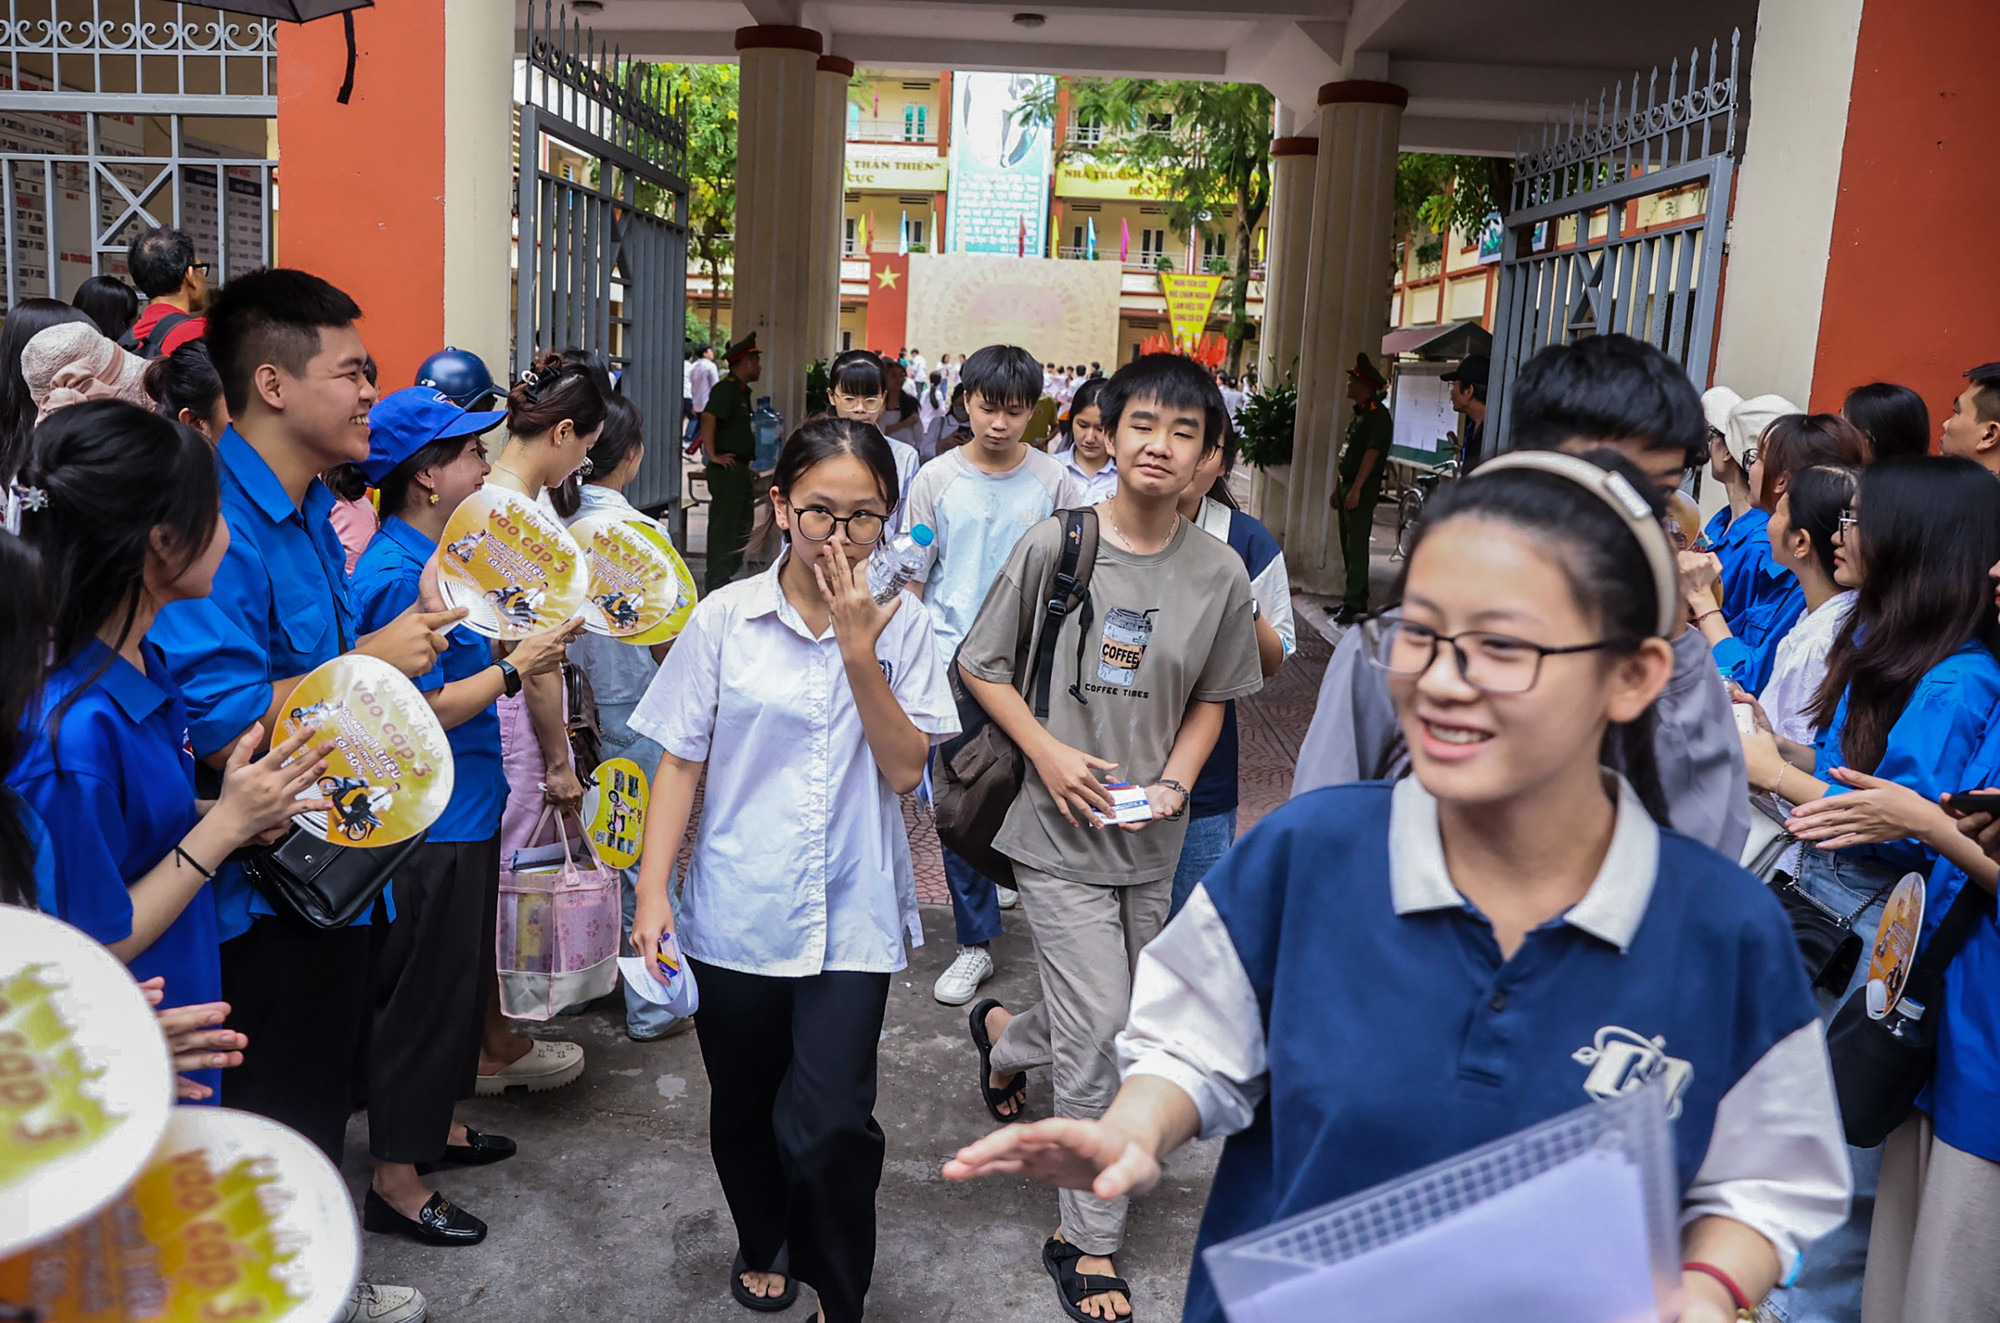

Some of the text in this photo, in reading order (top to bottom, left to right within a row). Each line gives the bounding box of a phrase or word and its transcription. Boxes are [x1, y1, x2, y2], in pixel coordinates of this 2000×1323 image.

[488, 508, 520, 536] vào
[521, 536, 553, 563] cấp
[553, 560, 570, 574] 3
[593, 531, 620, 553] vào
[521, 557, 549, 580] triệu
[1102, 643, 1140, 664] COFFEE
[1085, 683, 1119, 696] COFFEE
[352, 680, 384, 718] vào
[382, 722, 416, 761] cấp
[412, 763, 433, 778] 3
[345, 752, 367, 777] 50%
[374, 747, 404, 780] triệu
